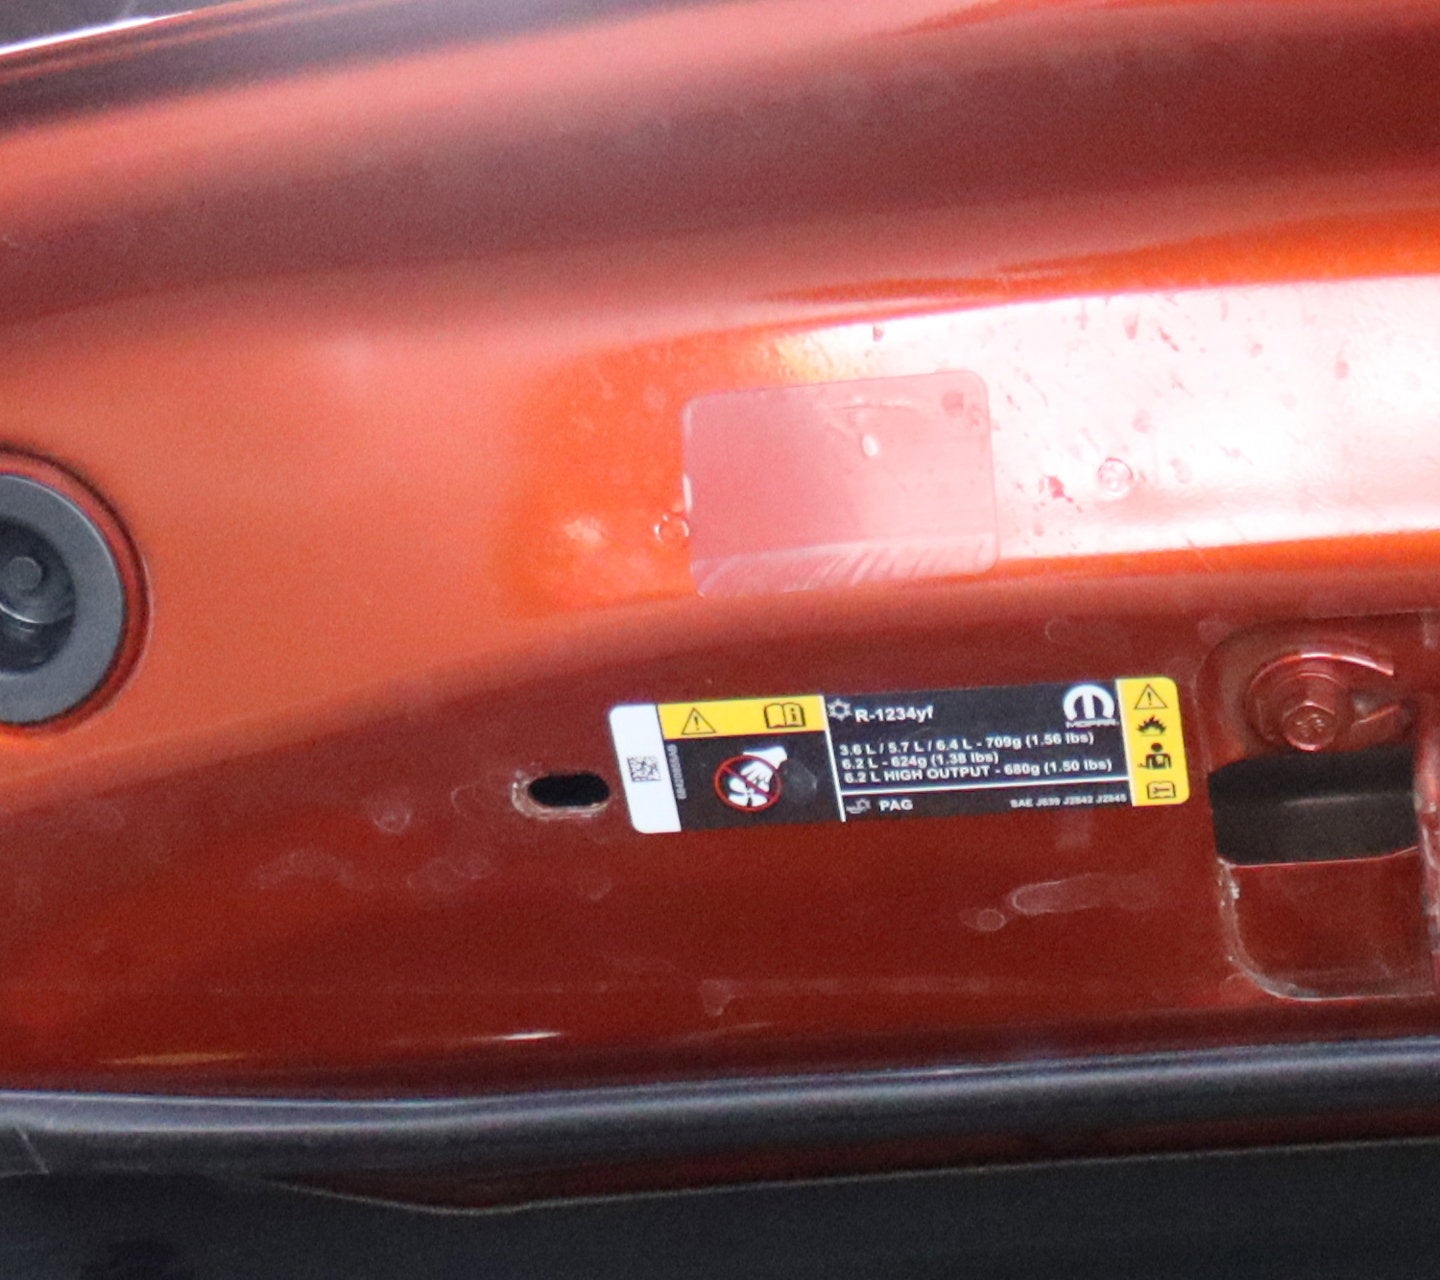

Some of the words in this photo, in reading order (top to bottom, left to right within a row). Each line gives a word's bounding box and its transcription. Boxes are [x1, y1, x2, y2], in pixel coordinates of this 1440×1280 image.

[854, 704, 934, 723] R-1234yf
[839, 744, 862, 756] 3.6
[866, 743, 876, 755] L
[888, 741, 909, 753] 5.7
[914, 741, 924, 752] L
[936, 739, 959, 751] 6.4
[962, 738, 973, 750] L
[986, 736, 1022, 749] 709g
[1026, 734, 1062, 748] (1.56
[1065, 731, 1094, 745] lbs)
[841, 758, 865, 770] 6.2
[868, 757, 878, 769] L
[890, 755, 927, 769] 624g
[931, 753, 967, 767] (1.38
[971, 751, 999, 764] lbs)
[844, 771, 867, 784] 6.2
[870, 770, 881, 782] L
[884, 769, 923, 781] HIGH
[926, 765, 990, 779] OUTPUT
[1004, 763, 1040, 776] 680g
[1044, 760, 1080, 774] (1.50
[1084, 758, 1113, 772] lbs)
[879, 799, 913, 812] PAG
